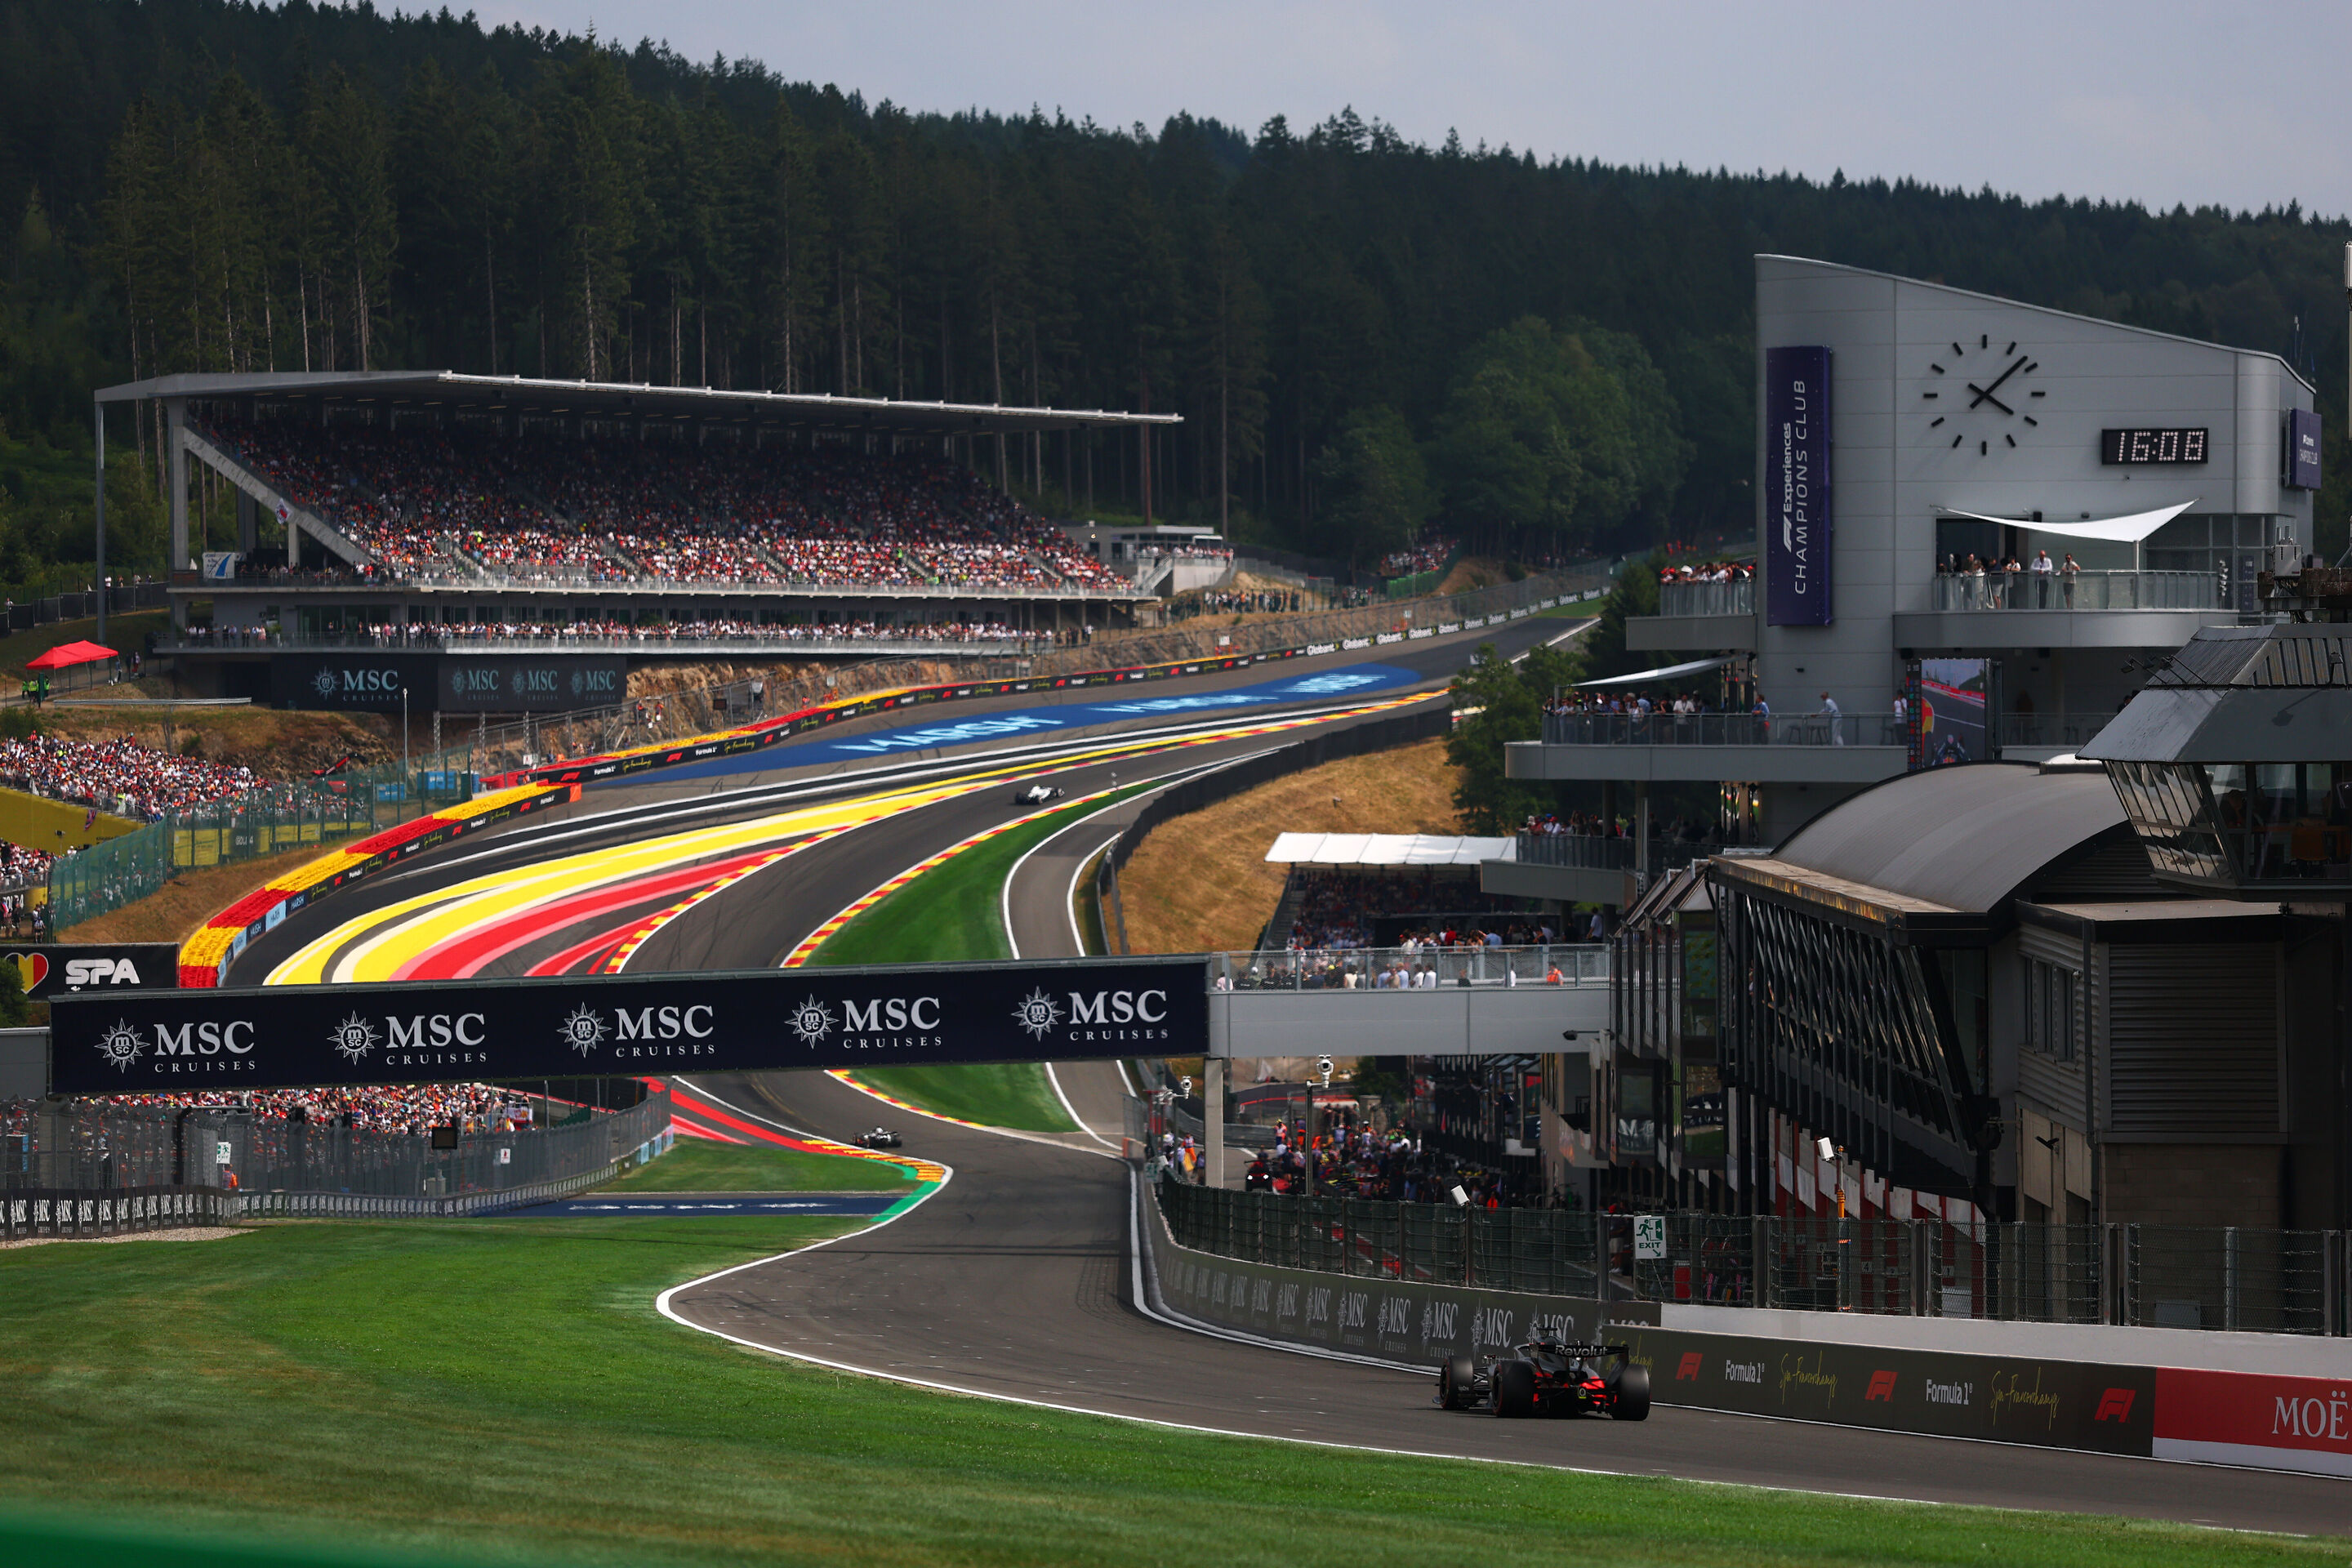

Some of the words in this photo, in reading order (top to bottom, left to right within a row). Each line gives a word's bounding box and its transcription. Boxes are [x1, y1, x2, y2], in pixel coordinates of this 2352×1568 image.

[1793, 381, 1806, 439] CLUB
[2118, 430, 2204, 462] 16:08
[1782, 422, 1793, 513] Experiences
[1795, 450, 1807, 595] CHAMPIONS
[343, 670, 398, 691] MSC
[468, 670, 499, 690] MSC
[528, 670, 558, 691] MSC
[586, 670, 616, 691] MSC
[65, 958, 140, 985] SPA
[614, 1005, 714, 1040] MSC
[842, 997, 940, 1032] MSC
[1068, 990, 1167, 1025] MSC
[154, 1021, 256, 1056] MSC
[385, 1013, 486, 1048] MSC
[844, 1036, 942, 1049] CRUISES
[1070, 1029, 1169, 1041] CRUISES
[155, 1061, 256, 1073] CRUISES
[386, 1052, 487, 1065] CRUISES
[616, 1044, 715, 1058] CRUISES
[1312, 1287, 1330, 1322] MSC
[1347, 1292, 1368, 1328] MSC
[1388, 1297, 1410, 1334] MSC
[1432, 1302, 1459, 1340] MSC
[1484, 1307, 1513, 1348] MSC
[1555, 1345, 1608, 1357] Revolut
[1726, 1360, 1756, 1383] Formula
[1926, 1379, 1962, 1404] Formula
[2272, 1390, 2352, 1440] MOË
